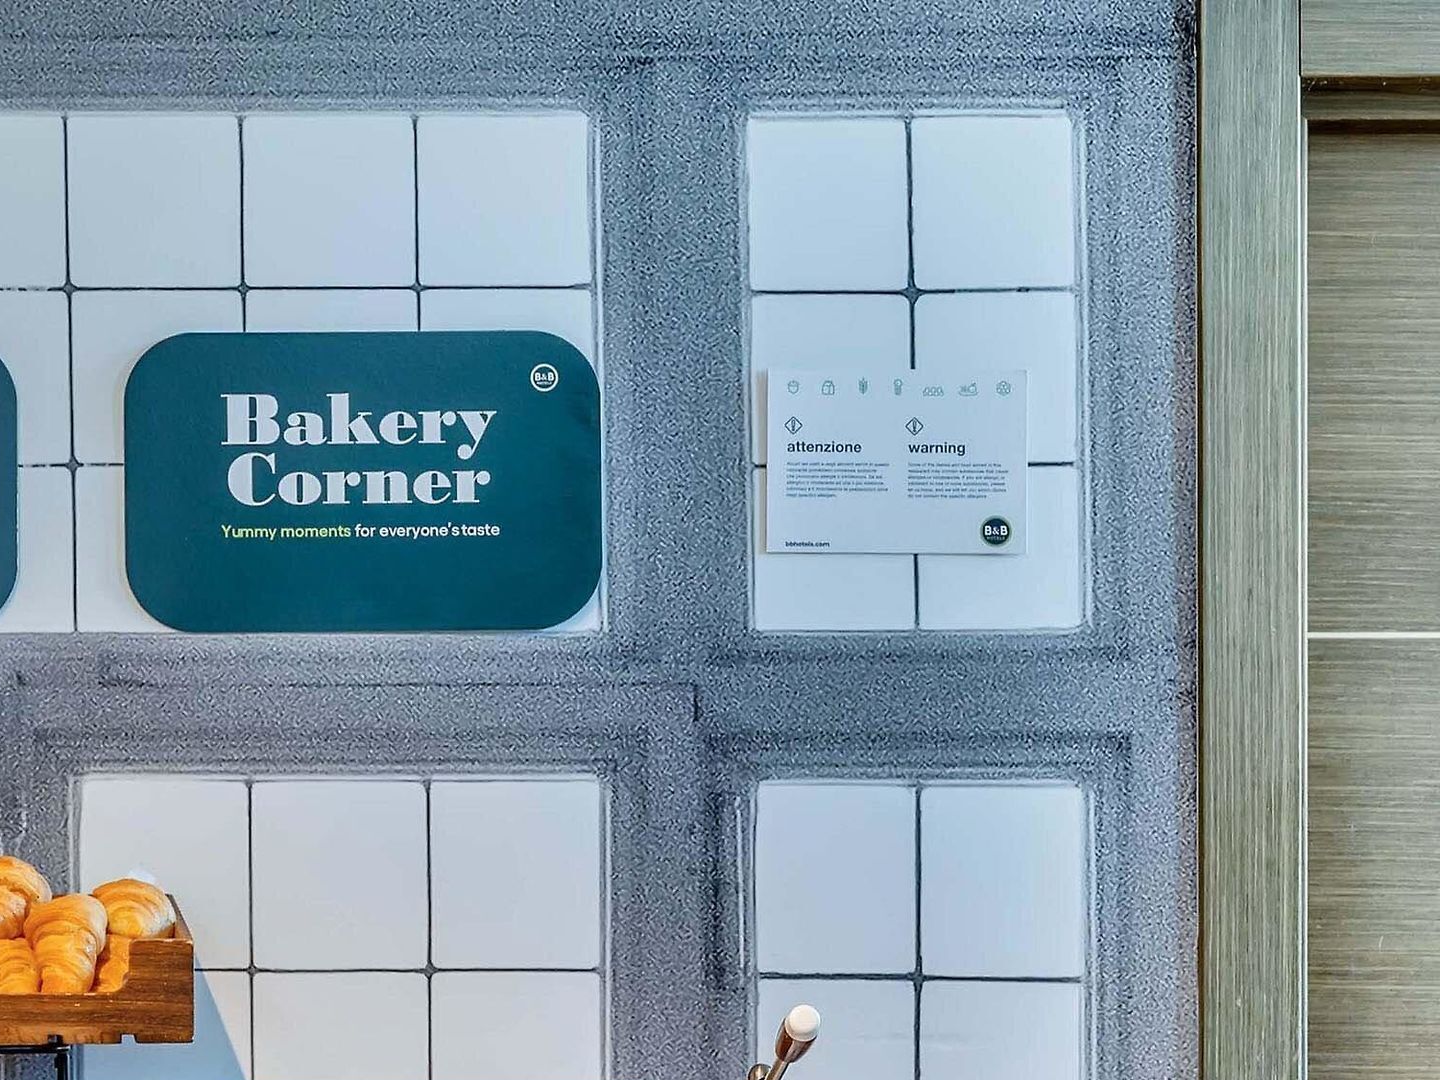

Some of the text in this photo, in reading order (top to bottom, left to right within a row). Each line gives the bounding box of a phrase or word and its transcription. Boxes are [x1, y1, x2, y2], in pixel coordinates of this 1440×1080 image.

[534, 372, 554, 381] B&B
[220, 392, 497, 460] Bakery
[787, 441, 862, 453] attenzione
[908, 442, 965, 456] warning
[227, 452, 491, 507] Corner
[221, 522, 500, 541] Yummy moments for everyone's taste
[984, 525, 1008, 536] B&B
